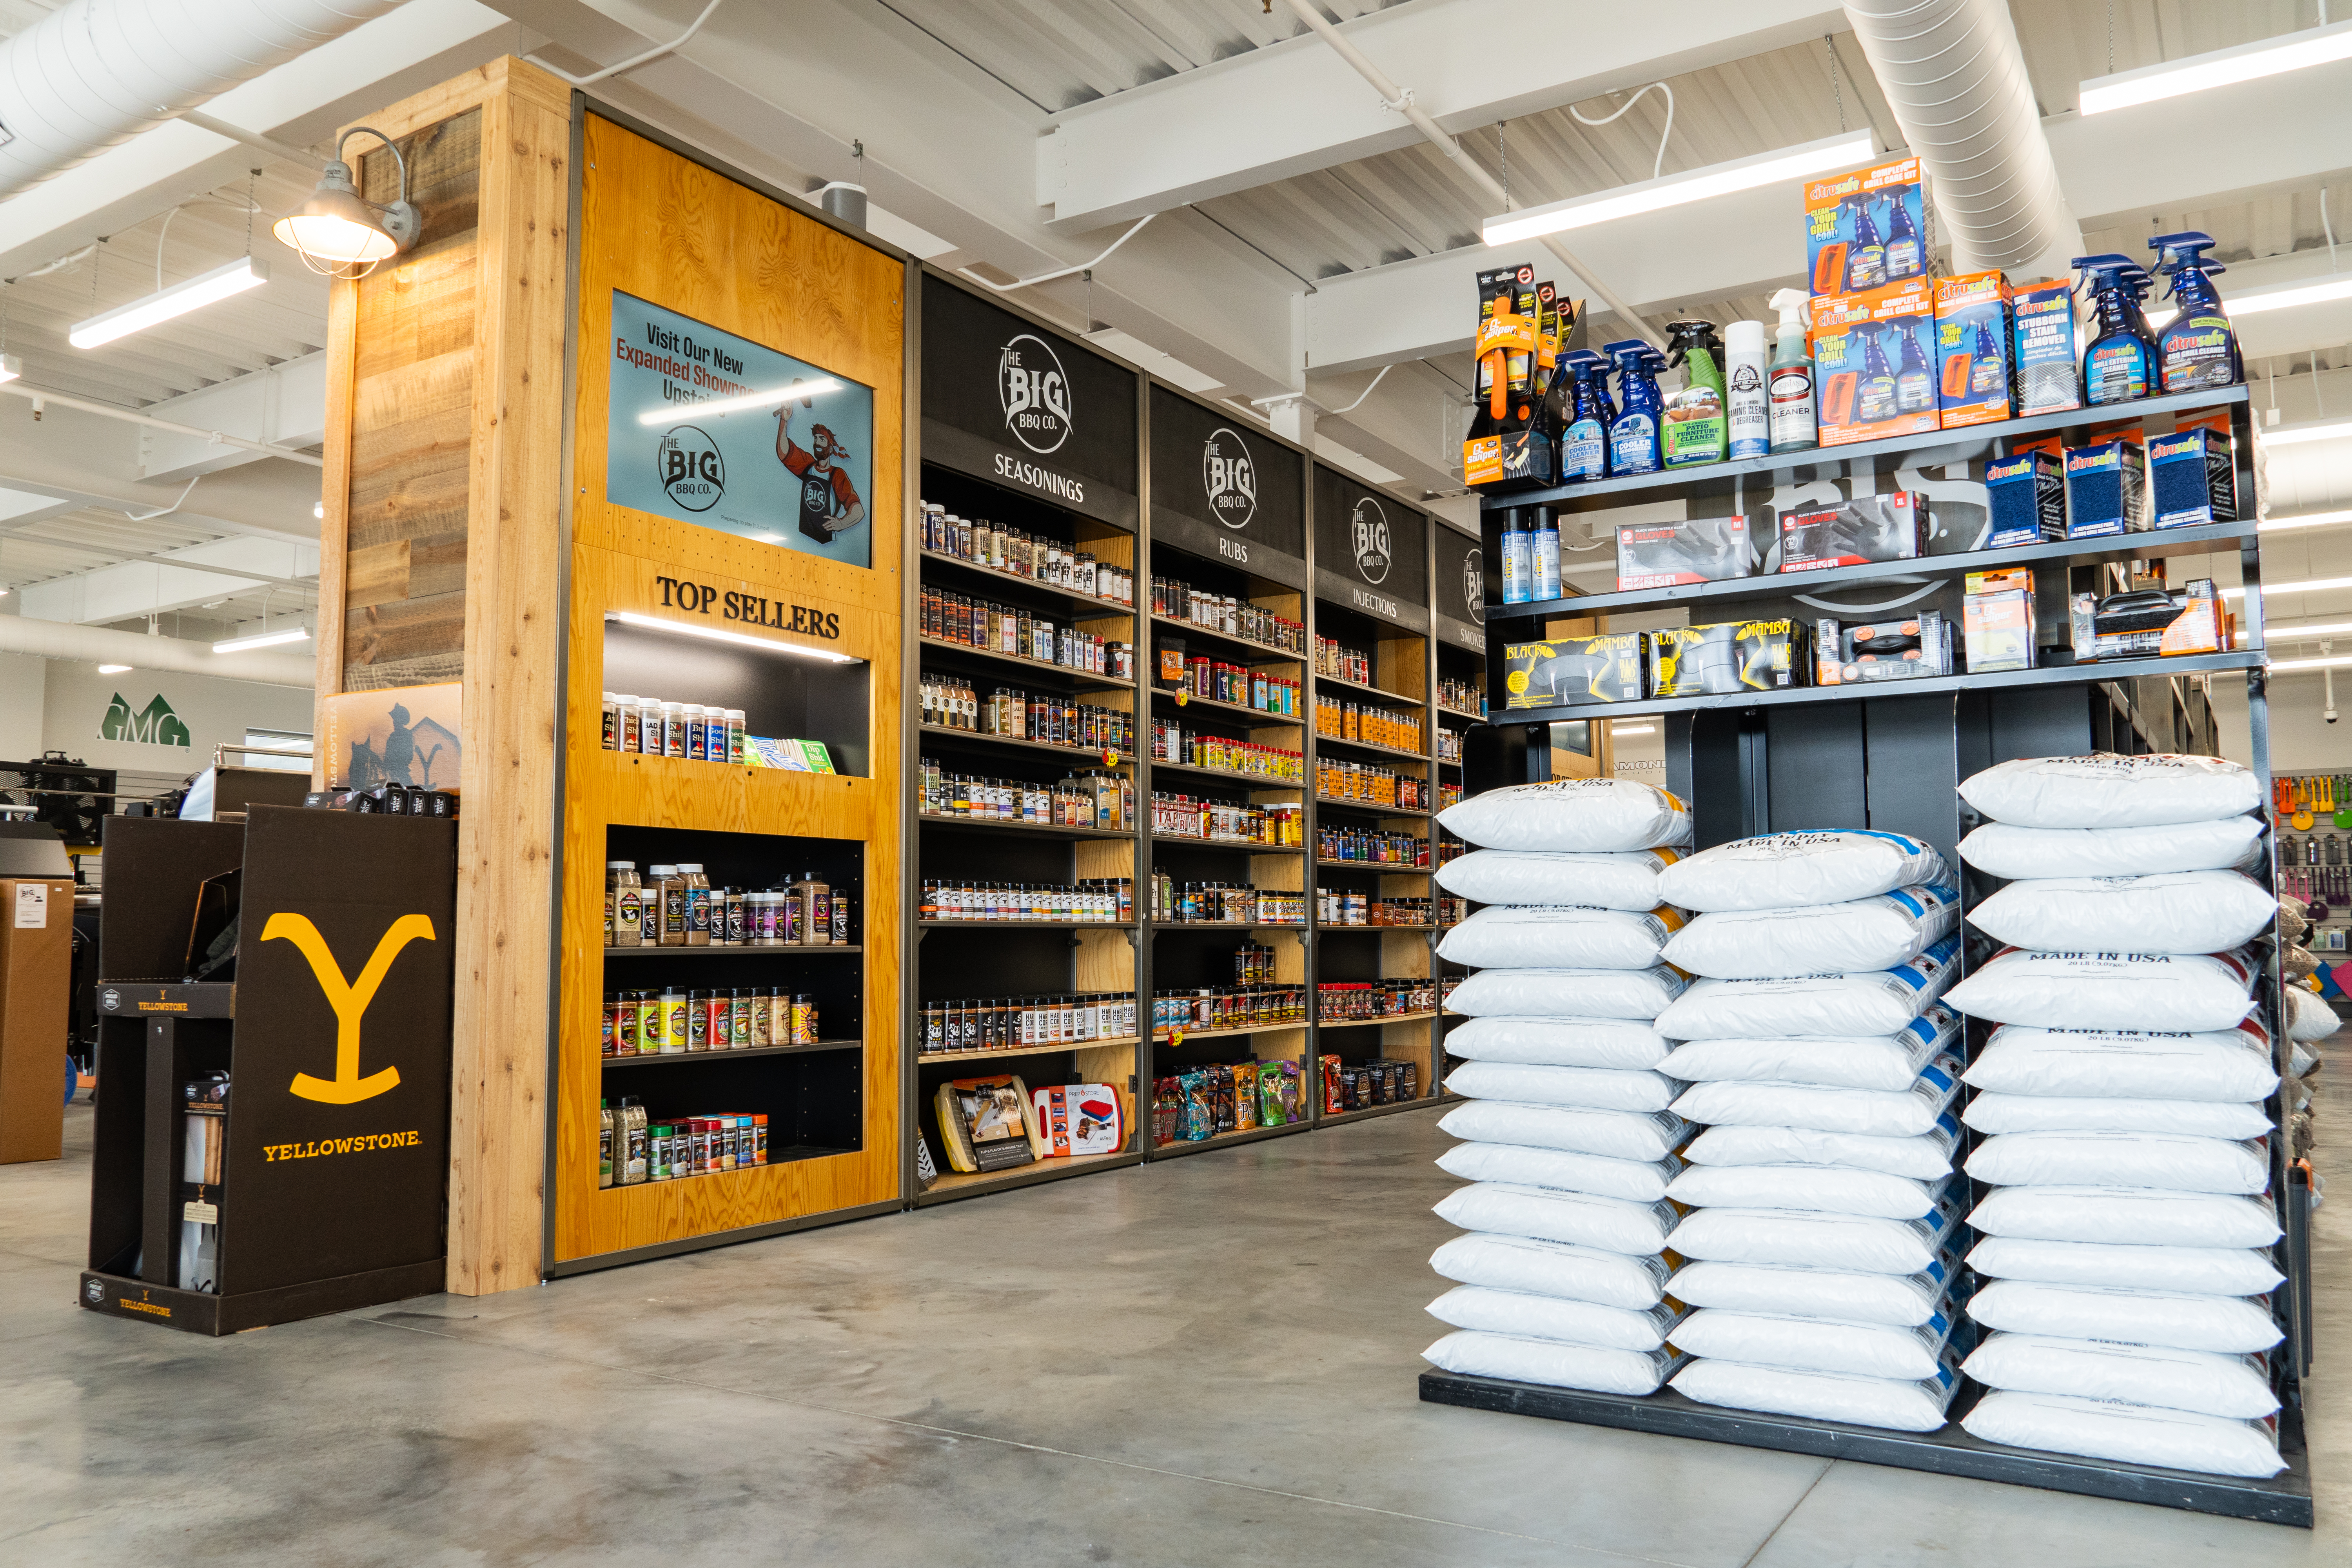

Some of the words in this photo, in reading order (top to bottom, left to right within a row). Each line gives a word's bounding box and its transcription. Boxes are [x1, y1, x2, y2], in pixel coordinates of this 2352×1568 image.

[1864, 178, 1883, 189] GRILL
[1884, 173, 1904, 184] CARE
[1904, 170, 1916, 180] KIT
[1810, 176, 1860, 200] citrusafe
[1811, 207, 1829, 217] CLEAN
[1814, 212, 1837, 225] YOUR
[1810, 221, 1835, 235] GRILL
[1816, 230, 1838, 242] COOL!
[1938, 276, 1997, 301] citrusafe
[1882, 295, 1920, 308] COMPLETE
[1938, 298, 1955, 309] BASIC
[1956, 295, 1971, 305] GRILL
[1972, 292, 1987, 301] CARE
[1987, 290, 1998, 298] KIT
[2016, 294, 2068, 317] citrusafe
[1818, 304, 1870, 327] citrusafe
[1874, 307, 1895, 318] GRILL
[1895, 304, 1915, 314] CARE
[1916, 301, 1929, 310] KIT
[1490, 318, 1501, 332] Q-
[1940, 323, 1956, 331] CLEAN
[2018, 313, 2068, 330] STUBBORN
[1485, 325, 1517, 342] swiper
[1818, 335, 1838, 344] CLEAN
[1943, 327, 1962, 337] YOUR
[2029, 325, 2057, 338] STAIN
[1822, 340, 1846, 352] YOUR
[1940, 336, 1960, 345] GRILL
[1944, 341, 1963, 350] COOL!
[2022, 334, 2066, 350] REMOVER
[2166, 329, 2225, 352] citrusafe
[647, 322, 679, 353] Visit
[684, 336, 710, 363] Our
[714, 347, 743, 376] New
[1818, 350, 1844, 363] GRILL
[2093, 343, 2137, 362] citrusafe
[2167, 351, 2180, 361] BBQ
[2181, 349, 2198, 359] GRILL
[2198, 346, 2226, 355] CLEANER
[617, 337, 690, 382] Expanded
[1000, 347, 1021, 373] THE
[1824, 359, 1847, 370] COOL!
[2092, 359, 2108, 370] GRILL
[2109, 356, 2139, 366] EXTERIOR
[2102, 363, 2128, 374] CLEANER
[1774, 379, 1804, 389] LOUISIANA
[1006, 367, 1073, 436] BIG
[1728, 407, 1746, 419] OAMING
[1737, 416, 1763, 425] DEGREASER
[1772, 408, 1809, 419] CLEANER
[1020, 413, 1040, 430] BBQ
[1042, 415, 1057, 430] CO.
[1666, 426, 1675, 454] citrusafe
[1677, 428, 1719, 437] FURNITURE
[1681, 434, 1715, 442] CLEANER
[661, 436, 679, 454] THE
[1204, 441, 1220, 462] THE
[1473, 443, 1484, 456] Q-
[1569, 445, 1600, 454] COOLER
[1619, 439, 1651, 450] COOLER
[1619, 446, 1651, 454] DEODORIZER
[2151, 436, 2201, 460] citrusafe
[1467, 448, 1499, 464] swiper
[1569, 450, 1600, 459] CLEANER
[2069, 449, 2117, 472] citrusafe
[664, 450, 726, 496] BIG
[994, 453, 1083, 503] SEASONINGS
[1987, 459, 2031, 481] citrusafe
[676, 484, 695, 495] BBQ
[698, 484, 711, 494] CO.
[1209, 458, 1258, 512] BIG
[805, 488, 825, 507] BIG
[1218, 495, 1234, 508] BBQ
[1235, 496, 1246, 508] CO.
[721, 515, 739, 524] Preparing
[1353, 508, 1364, 528] THE
[1797, 512, 1837, 526] GLOVES
[1635, 530, 1675, 540] GLOVES
[1220, 537, 1247, 563] RUBS
[1356, 522, 1392, 569] BIG
[1363, 555, 1374, 566] BBQ
[1375, 556, 1383, 566] CO.
[1504, 535, 1512, 579] citrushine
[1534, 533, 1543, 577] citrushine
[1464, 559, 1472, 578] THE
[657, 575, 717, 614] TOP
[723, 591, 840, 639] SELLERS
[1353, 588, 1396, 618] INJECTIONS
[1977, 611, 2013, 624] swiper
[1651, 630, 1689, 646] BLACK
[1746, 620, 1790, 636] MAMBA
[1828, 623, 1838, 650] swiper
[1506, 644, 1543, 659] BLACK
[1595, 635, 1636, 651] MAMBA
[97, 702, 182, 747] GMG
[805, 745, 820, 755] Dip
[1725, 839, 1775, 849] MADE
[2028, 953, 2090, 961] MADE
[2127, 954, 2171, 963] USA
[138, 1002, 188, 1011] YELLOWSTONE
[260, 912, 436, 1105] Y
[263, 1130, 419, 1163] YELLOWSTONE
[120, 1298, 172, 1317] YELLOWSTONE
